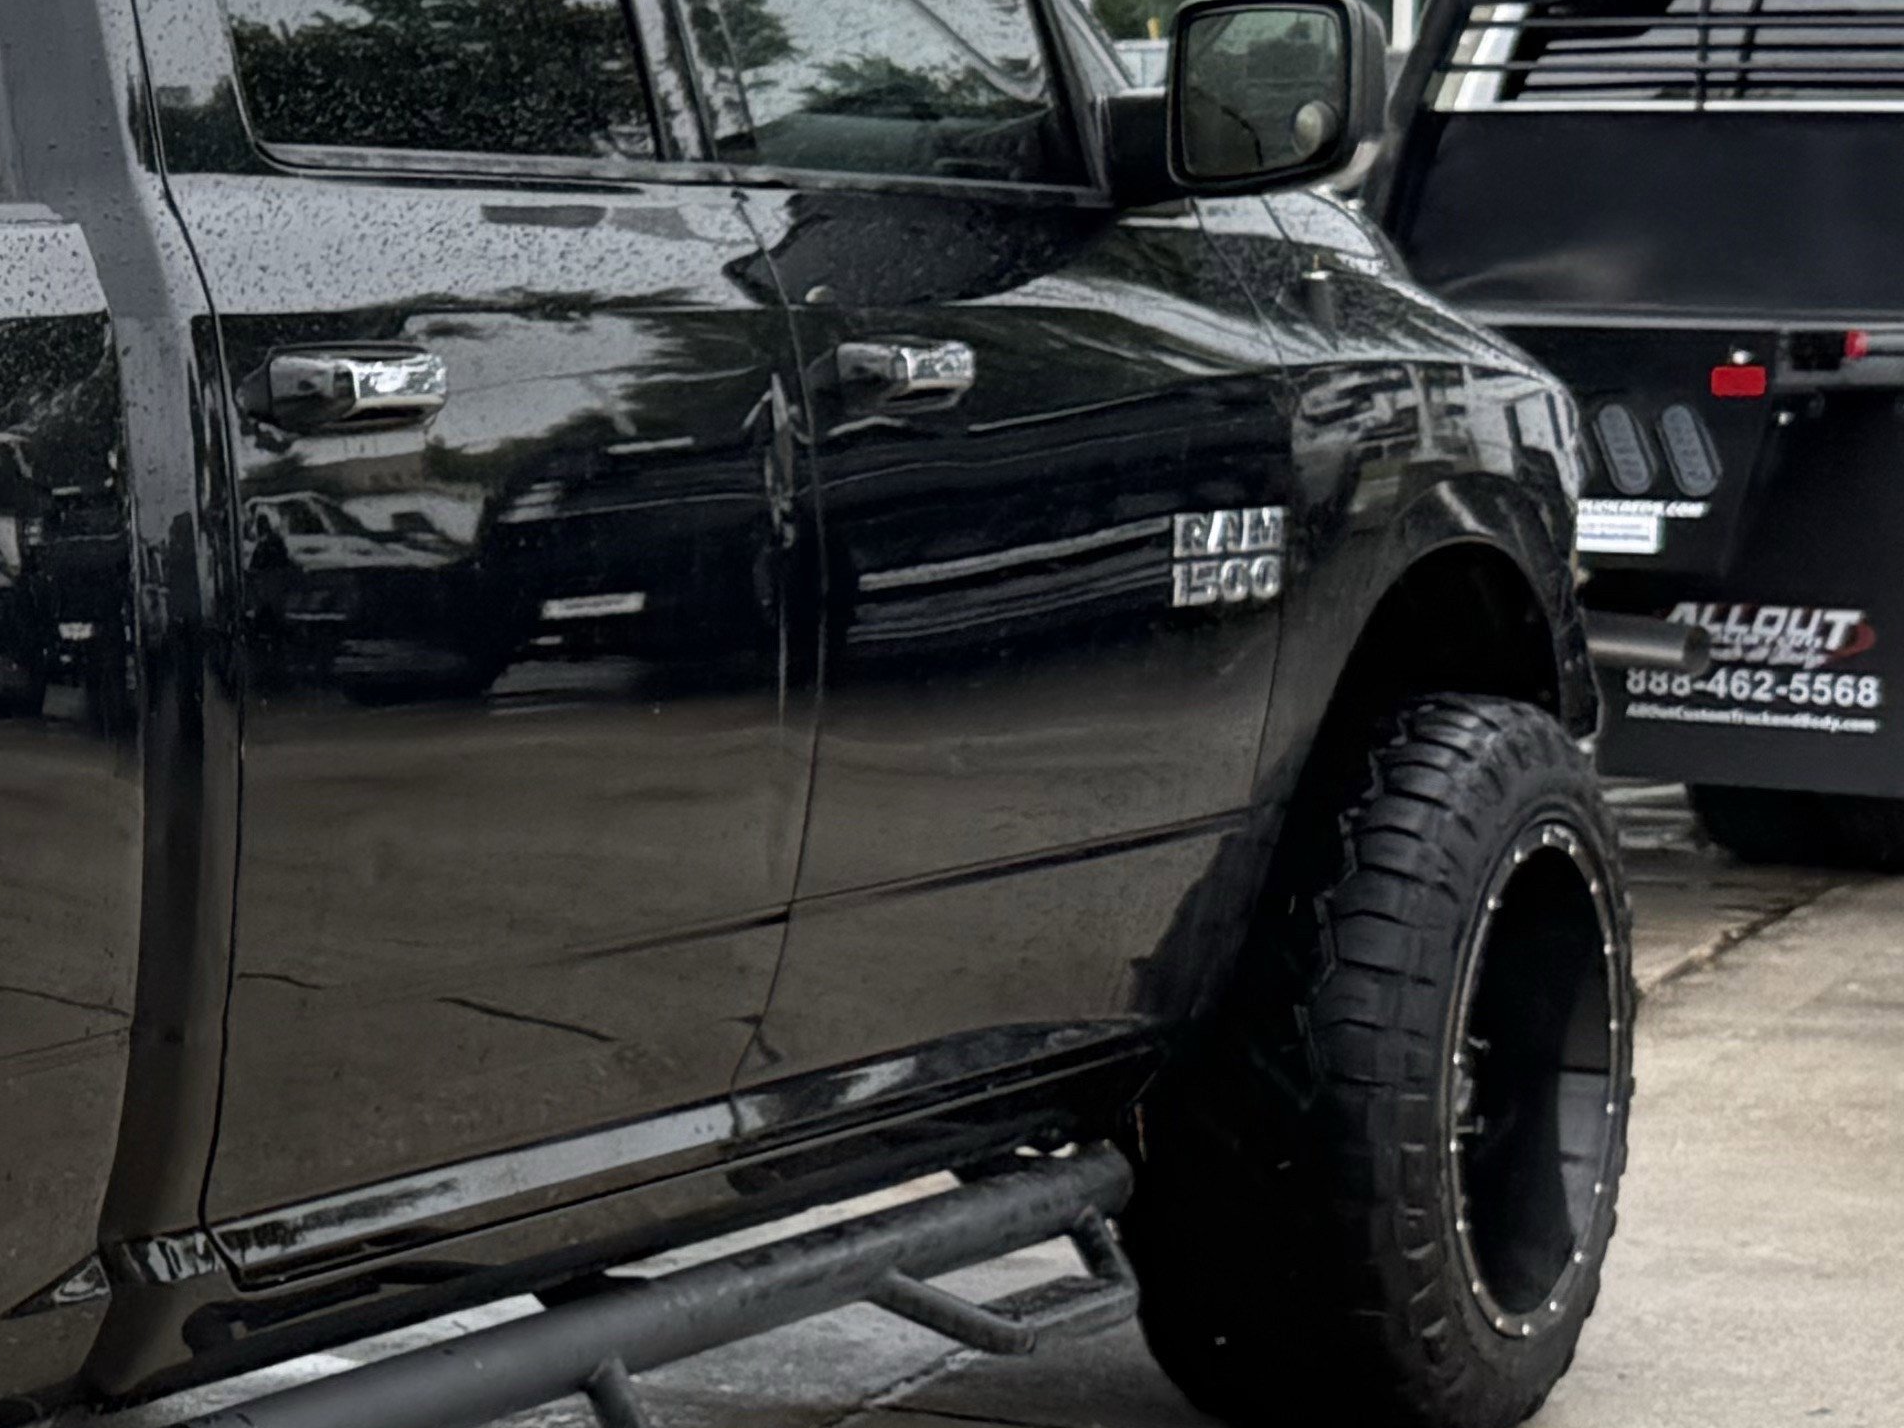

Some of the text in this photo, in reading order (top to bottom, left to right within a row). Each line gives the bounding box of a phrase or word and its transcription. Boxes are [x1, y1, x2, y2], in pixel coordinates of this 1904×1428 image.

[1173, 506, 1284, 557] RAM
[1172, 556, 1281, 608] 1500
[1626, 668, 1879, 709] 888-462-5568
